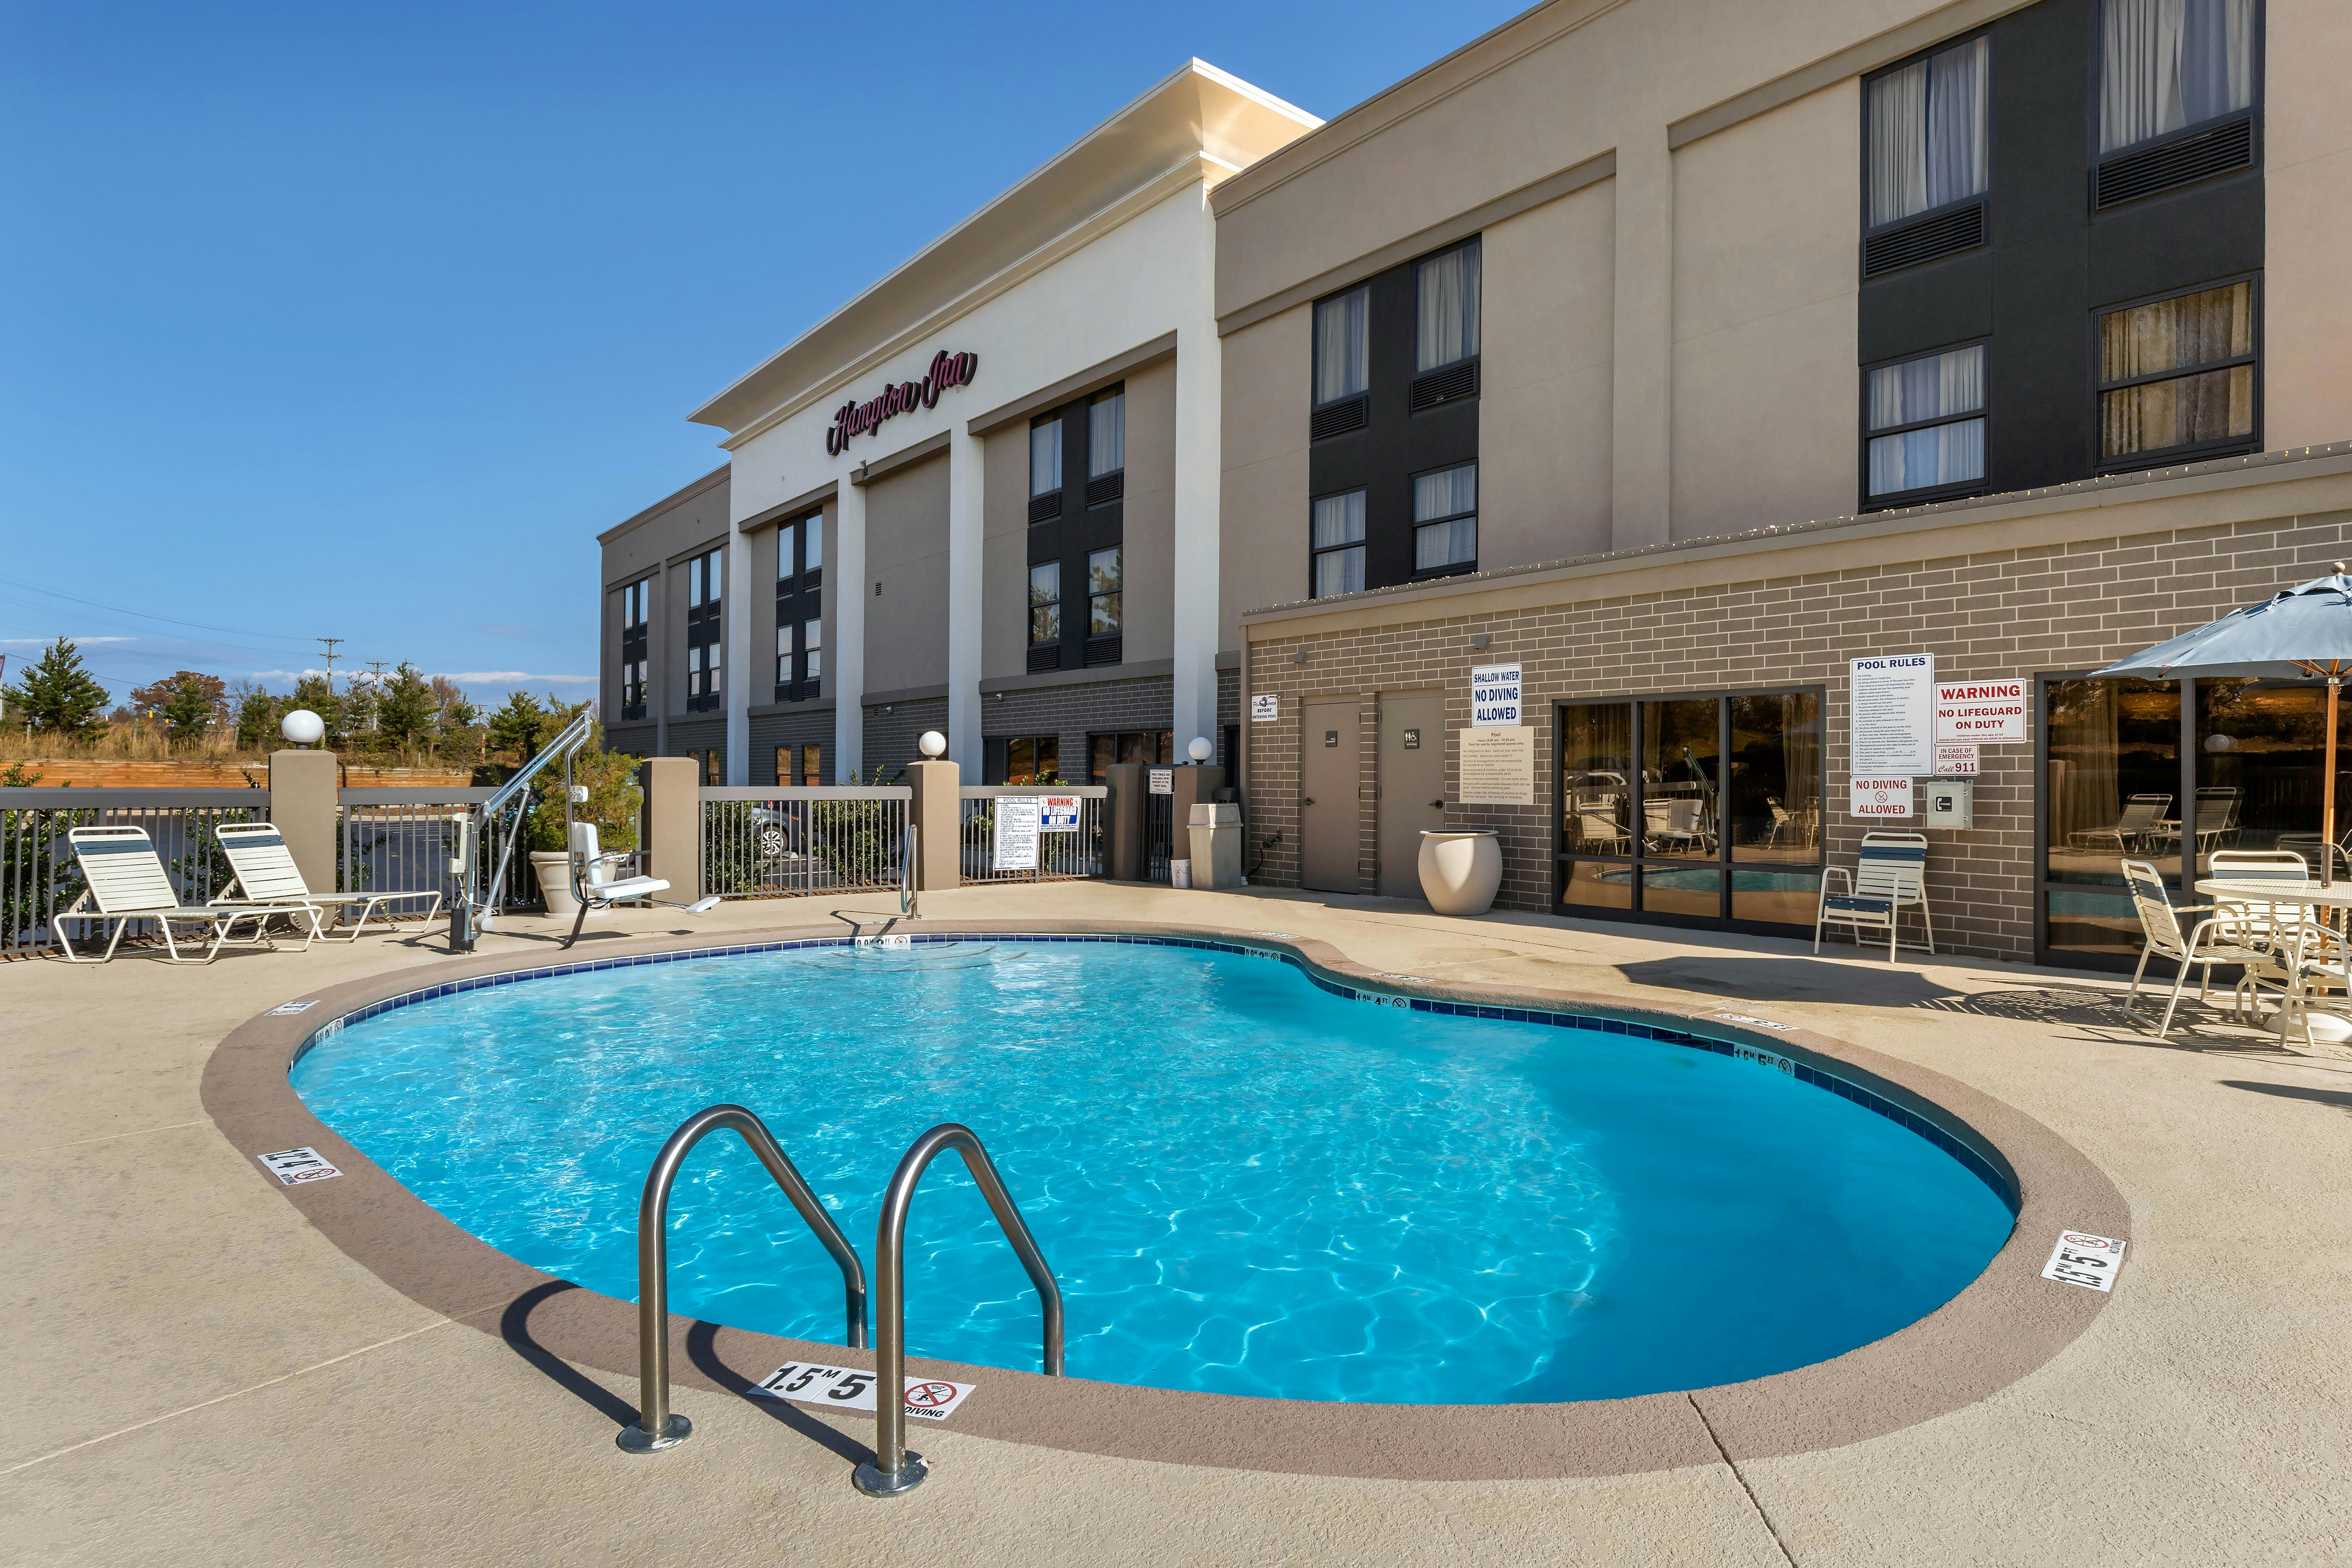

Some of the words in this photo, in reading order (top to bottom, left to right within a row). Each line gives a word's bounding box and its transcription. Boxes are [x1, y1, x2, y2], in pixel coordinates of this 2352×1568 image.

[826, 381, 921, 456] Hampton
[921, 350, 978, 409] Inn
[1857, 661, 1886, 670] POOL
[1890, 658, 1925, 668] RULES
[1474, 673, 1499, 683] SHALLOW
[1501, 671, 1519, 680] WATER
[1475, 689, 1487, 702] NO
[1490, 687, 1518, 701] DIVING
[1941, 685, 2020, 700] WARNING
[1477, 707, 1516, 721] ALLOWED
[1958, 706, 2022, 717] LIFEGUARD
[1955, 721, 1971, 729] ON
[1975, 720, 2004, 729] DUTY
[1955, 763, 1975, 772] 911
[1856, 781, 1870, 789] NO
[1872, 780, 1907, 789] DIVING
[1043, 807, 1050, 816] NO
[1050, 807, 1076, 816] LIFEGUARD
[1859, 805, 1905, 814] ALLOWED
[1049, 816, 1056, 825] ON
[1057, 816, 1070, 824] DUTY
[905, 1407, 945, 1417] DIVING
